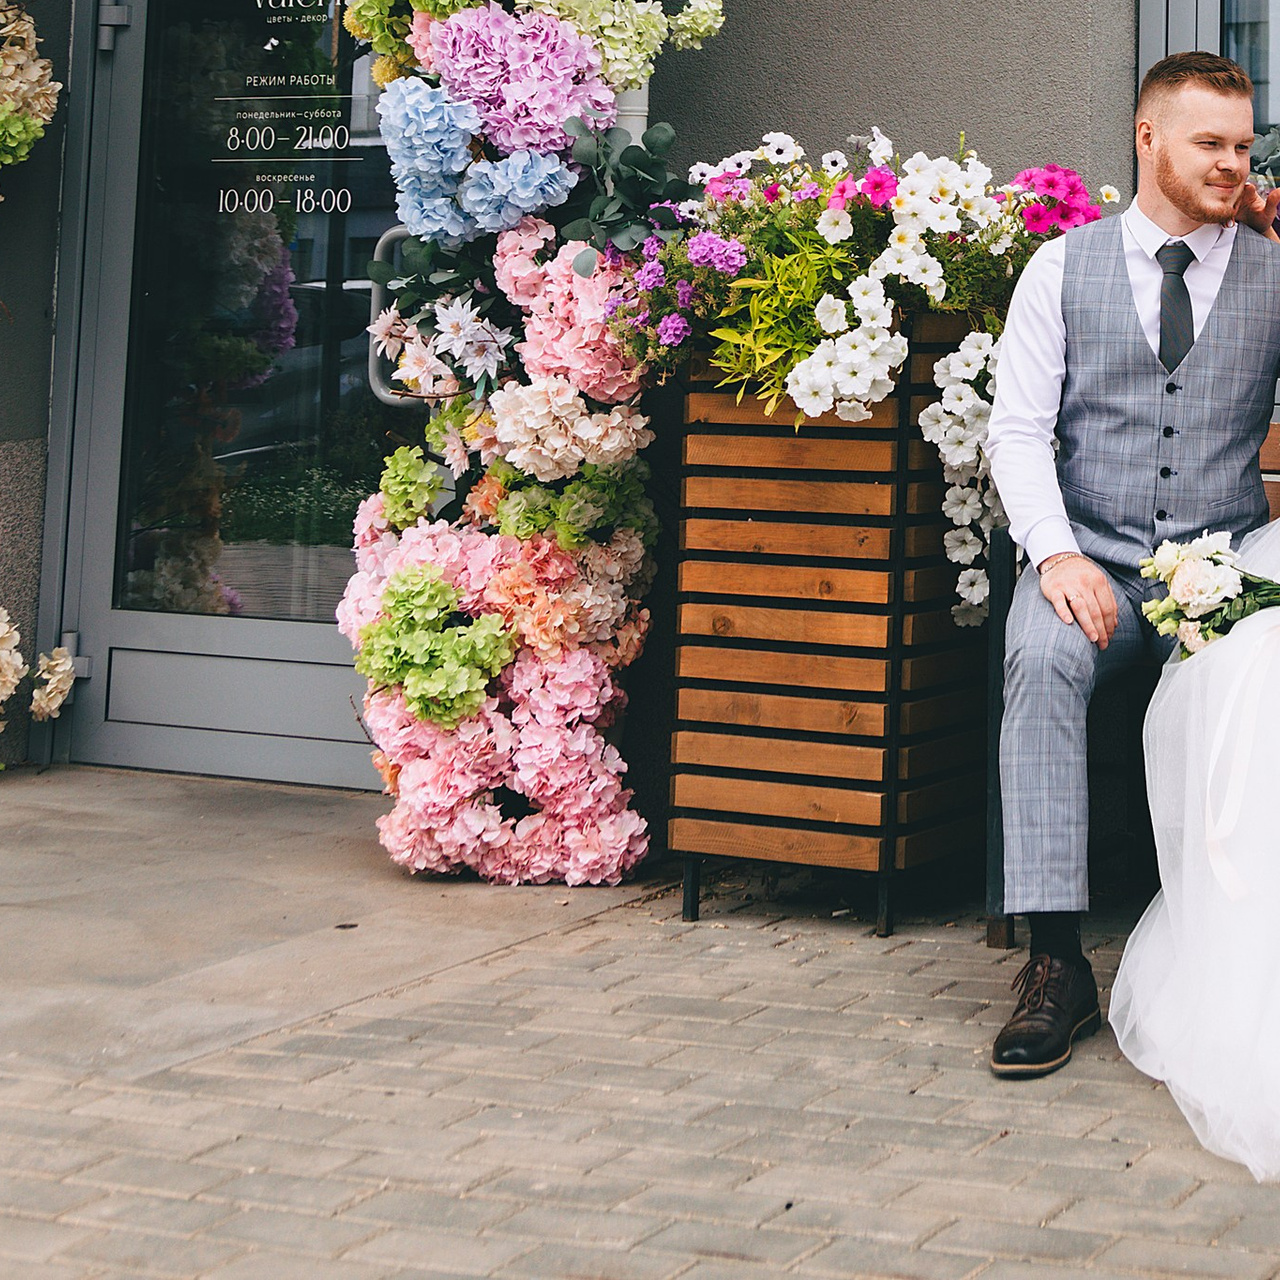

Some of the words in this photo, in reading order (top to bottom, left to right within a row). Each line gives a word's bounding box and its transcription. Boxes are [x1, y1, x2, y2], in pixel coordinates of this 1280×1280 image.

[266, 15, 293, 24] цветы
[300, 13, 328, 24] декор
[246, 76, 286, 87] РЕЖИМ
[289, 74, 336, 86] РАБОТЫ
[255, 173, 316, 183] воскресенье
